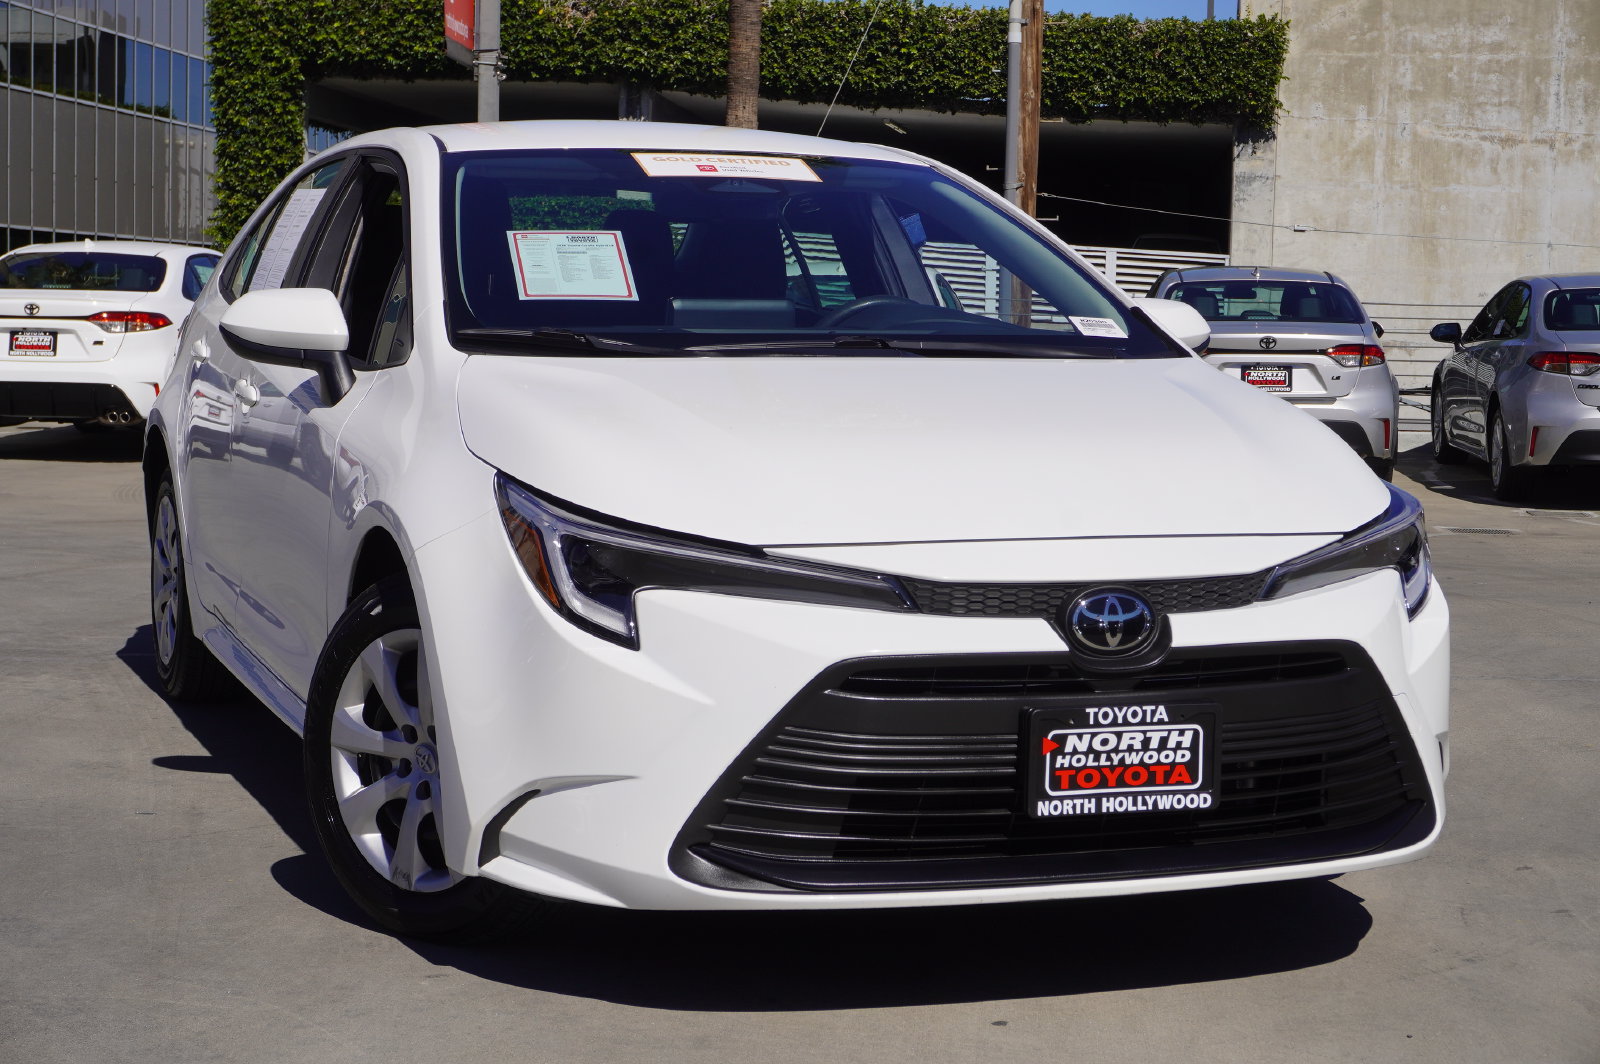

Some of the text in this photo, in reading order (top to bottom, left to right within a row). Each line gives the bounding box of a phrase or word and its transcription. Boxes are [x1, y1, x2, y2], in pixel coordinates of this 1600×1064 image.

[706, 157, 791, 167] CERTIFIED
[1086, 705, 1169, 725] TOYOTA
[1064, 730, 1194, 753] NORTH
[1055, 750, 1191, 768] HOLLYWOOD
[1055, 765, 1193, 790] TOYOTA
[1037, 793, 1212, 817] NORTH HOLLYWOOD
